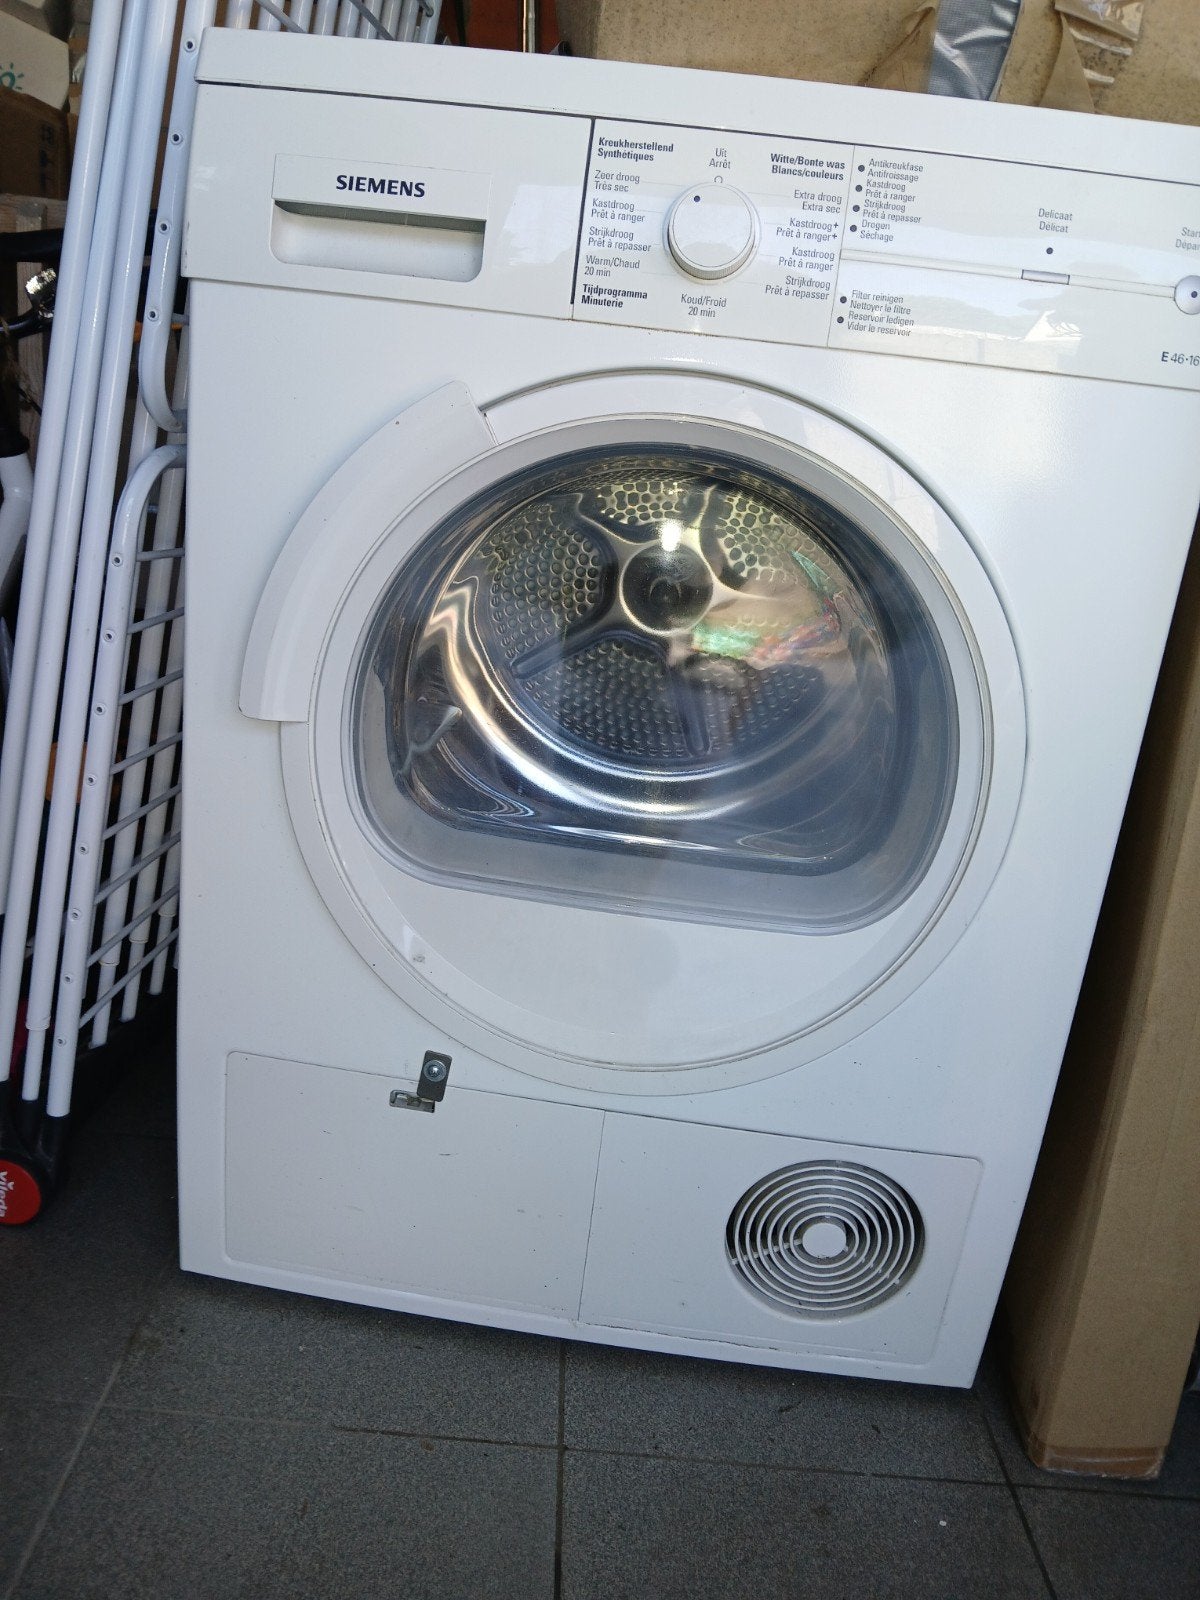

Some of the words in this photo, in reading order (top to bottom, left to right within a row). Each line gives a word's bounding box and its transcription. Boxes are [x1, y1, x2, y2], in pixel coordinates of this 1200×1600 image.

[599, 137, 674, 152] Kreukherstellend
[598, 148, 654, 162] Synthétiques
[715, 148, 727, 157] Uit
[709, 158, 731, 169] Arrêt
[770, 153, 824, 167] Witte/Bonte
[826, 161, 845, 169] was
[868, 158, 923, 172] Antikreukfase
[594, 169, 616, 180] Zeer
[616, 172, 640, 184] droog
[771, 165, 844, 180] Blancs/couleurs
[867, 169, 919, 183] Antifroissage
[336, 174, 425, 198] SIEMENS
[595, 180, 612, 191] Très
[615, 184, 629, 192] sec
[866, 179, 906, 192] Kastdroog
[794, 189, 815, 200] Extra
[818, 192, 842, 204] droog
[865, 189, 881, 198] Prêt
[883, 190, 888, 199] à
[890, 194, 916, 203] ranger
[592, 198, 635, 212] Kastdroog
[802, 201, 823, 211] Extra
[826, 206, 841, 214] sec
[864, 199, 906, 213] Strijkdroog
[591, 209, 608, 219] Prêt
[610, 211, 615, 220] à
[618, 214, 645, 223] ranger
[862, 209, 879, 218] Prêt
[881, 211, 886, 219] à
[888, 214, 921, 223] repasser
[1038, 208, 1073, 221] Delicaat
[861, 219, 890, 230] Drogen
[589, 226, 634, 240] Strijkdroog
[776, 227, 794, 237] Prêt
[796, 229, 801, 238] à
[860, 230, 894, 242] Séchage
[588, 237, 605, 247] Prêt
[607, 239, 612, 248] à
[615, 242, 651, 252] repasser
[792, 247, 835, 261] Kastdroog
[586, 255, 640, 268] Warm/Chaud
[778, 257, 796, 267] Prêt
[798, 258, 803, 268] à
[806, 262, 833, 272] ranger
[584, 266, 594, 275] 20
[596, 268, 611, 276] min
[785, 275, 831, 290] Strijkdroog
[583, 284, 648, 299] Tijdprogramma
[765, 284, 783, 296] Prêt
[785, 286, 790, 296] à
[792, 289, 829, 300] repasser
[851, 289, 871, 300] Filter
[872, 293, 903, 304] reinigen
[581, 295, 624, 308] Minuterie
[681, 293, 727, 307] Koud/Froid
[688, 306, 698, 316] 20
[700, 308, 716, 317] min
[850, 300, 883, 312] Nettoyer
[885, 304, 891, 312] le
[893, 304, 911, 315] filtre
[847, 321, 866, 331] Vider
[869, 324, 876, 332] le
[886, 316, 914, 327] ledigen
[1161, 351, 1169, 362] E
